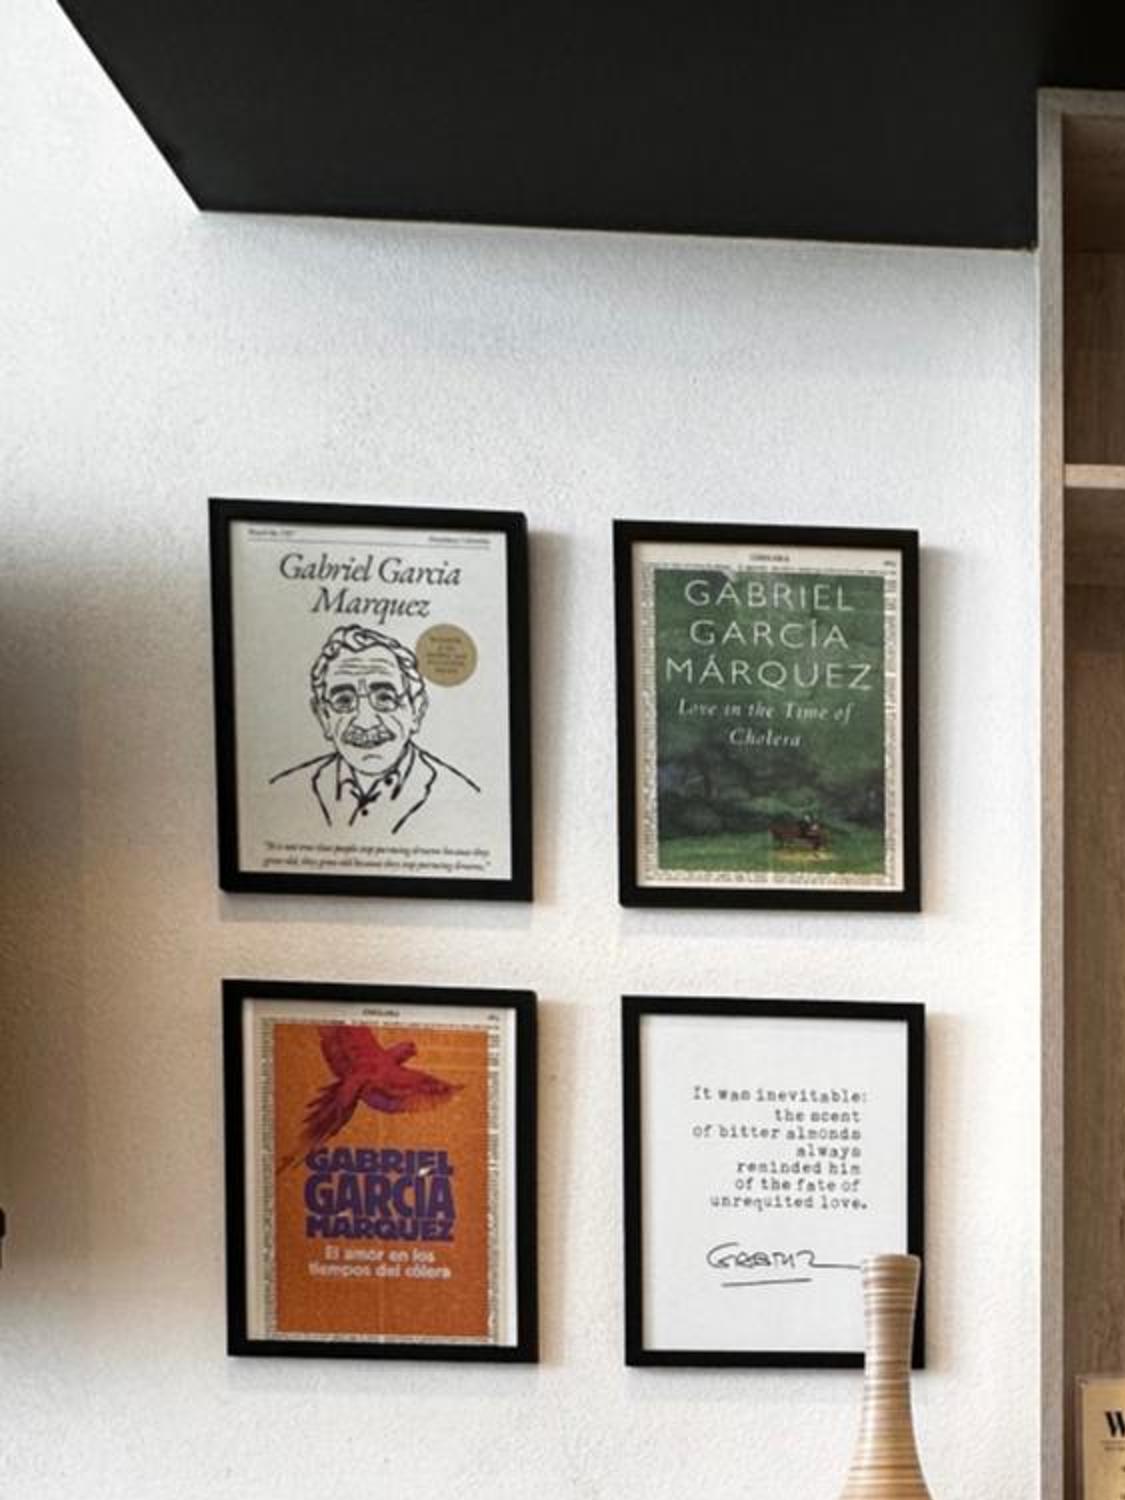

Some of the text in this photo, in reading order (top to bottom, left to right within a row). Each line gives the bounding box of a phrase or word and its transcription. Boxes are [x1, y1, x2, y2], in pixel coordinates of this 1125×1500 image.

[279, 551, 463, 587] Gabriel Garcia
[311, 587, 431, 624] Marquez
[684, 579, 855, 612] GABRIEL
[689, 618, 849, 650] GARCÍA
[665, 653, 873, 692] MÁRQUEZ
[678, 698, 855, 725] Love in the Time of
[729, 726, 801, 748] Cholera
[693, 1085, 868, 1104] It was inevitable:
[774, 1108, 861, 1124] the scent
[692, 1124, 861, 1141] of bitter almonds
[304, 1147, 455, 1176] GABRIEL
[796, 1144, 861, 1161] always
[736, 1160, 861, 1176] reminded him
[735, 1177, 861, 1192] of the fate of
[709, 1195, 868, 1213] unrequited love.
[387, 1250, 409, 1263] en
[412, 1248, 436, 1263] los
